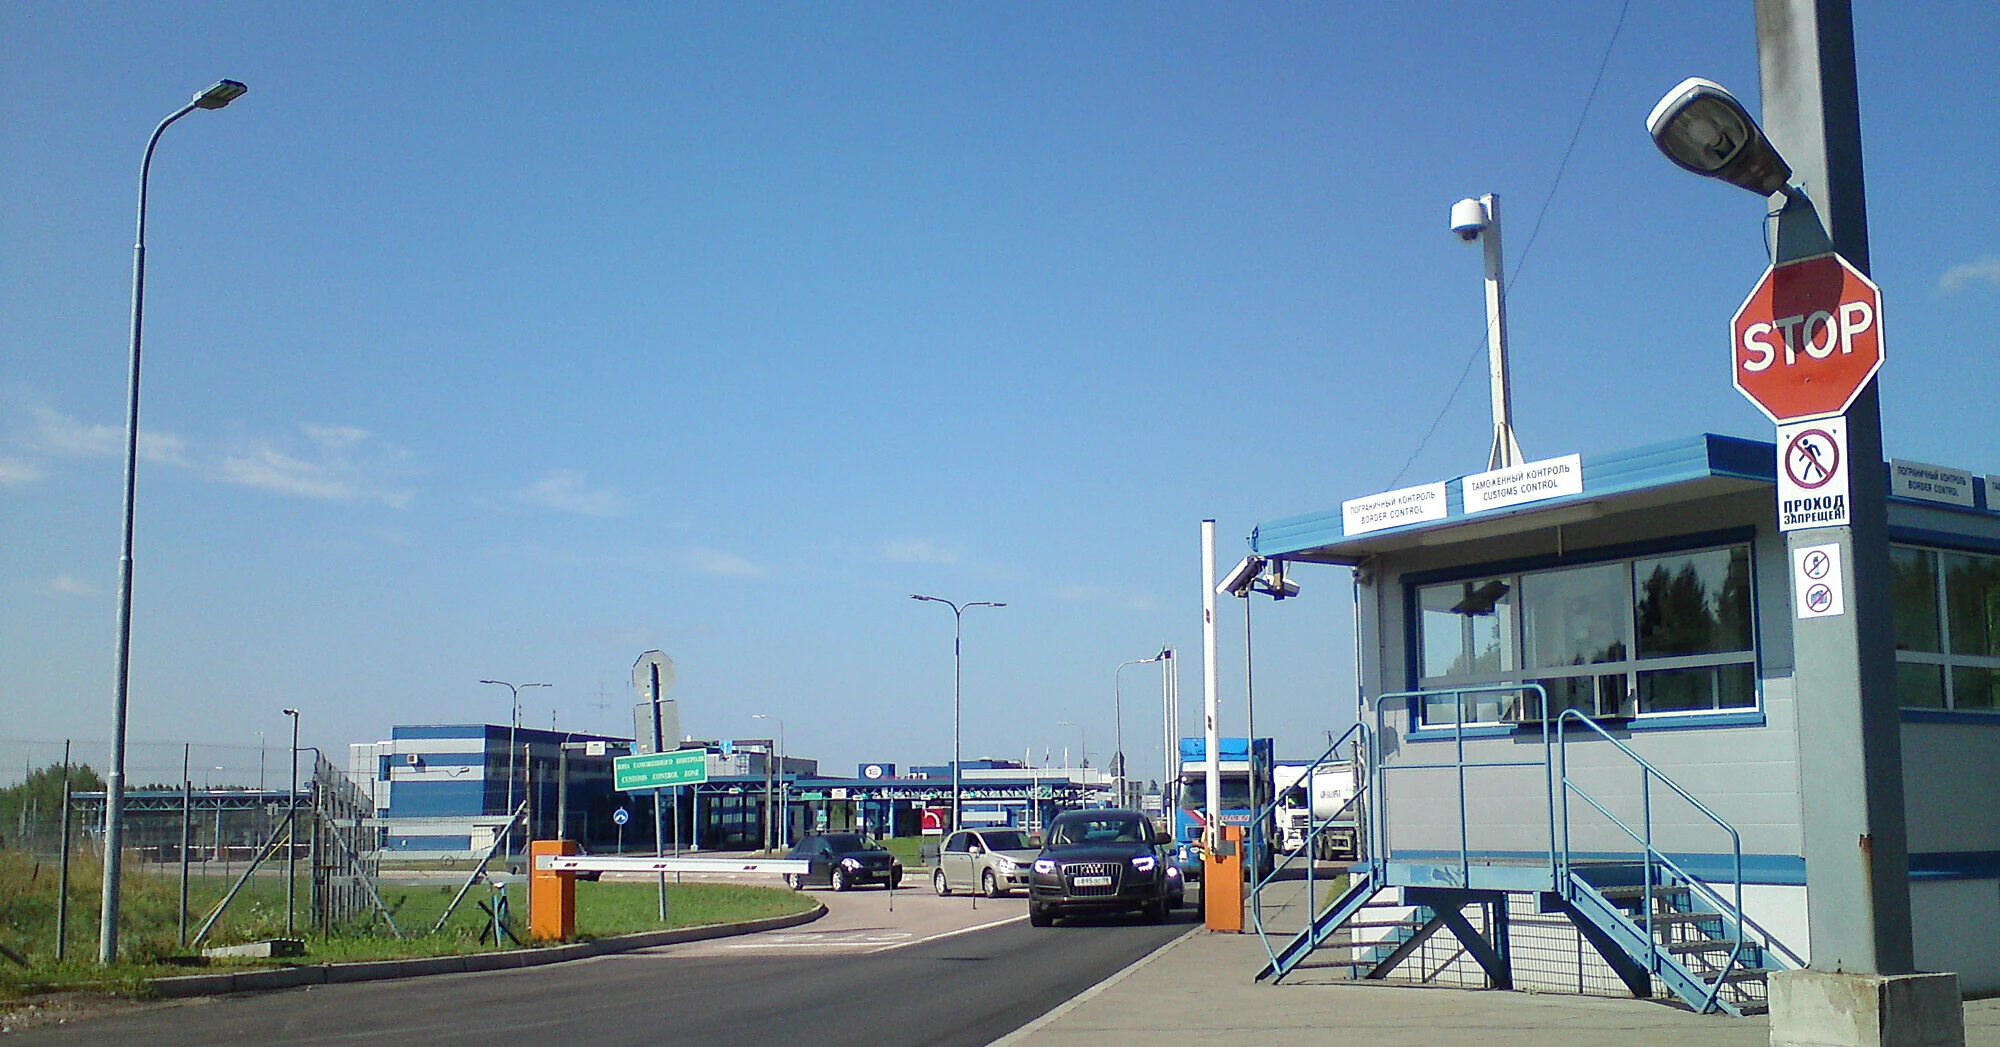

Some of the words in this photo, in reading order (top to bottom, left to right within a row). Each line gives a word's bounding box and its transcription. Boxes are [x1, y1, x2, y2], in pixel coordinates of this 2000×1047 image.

[1743, 301, 1873, 372] STOP
[1472, 471, 1524, 491] ТАМОЖЕННЫЙ
[1527, 464, 1570, 480] КОНТРОЛЬ
[1908, 480, 1932, 492] BORDER
[1483, 486, 1518, 501] CUSTOMS
[1521, 479, 1558, 494] CONTROL
[1350, 497, 1396, 515] ПОГРАНИЧНЫЙ
[1398, 491, 1436, 504] КОНТРОЛЬ
[1784, 494, 1845, 514] ПРОХОД
[1361, 511, 1387, 525] BORDER
[1390, 505, 1424, 519] CONTROL
[1783, 508, 1845, 525] ЗАПРЕЩЕН!
[652, 771, 679, 780] CONTROL
